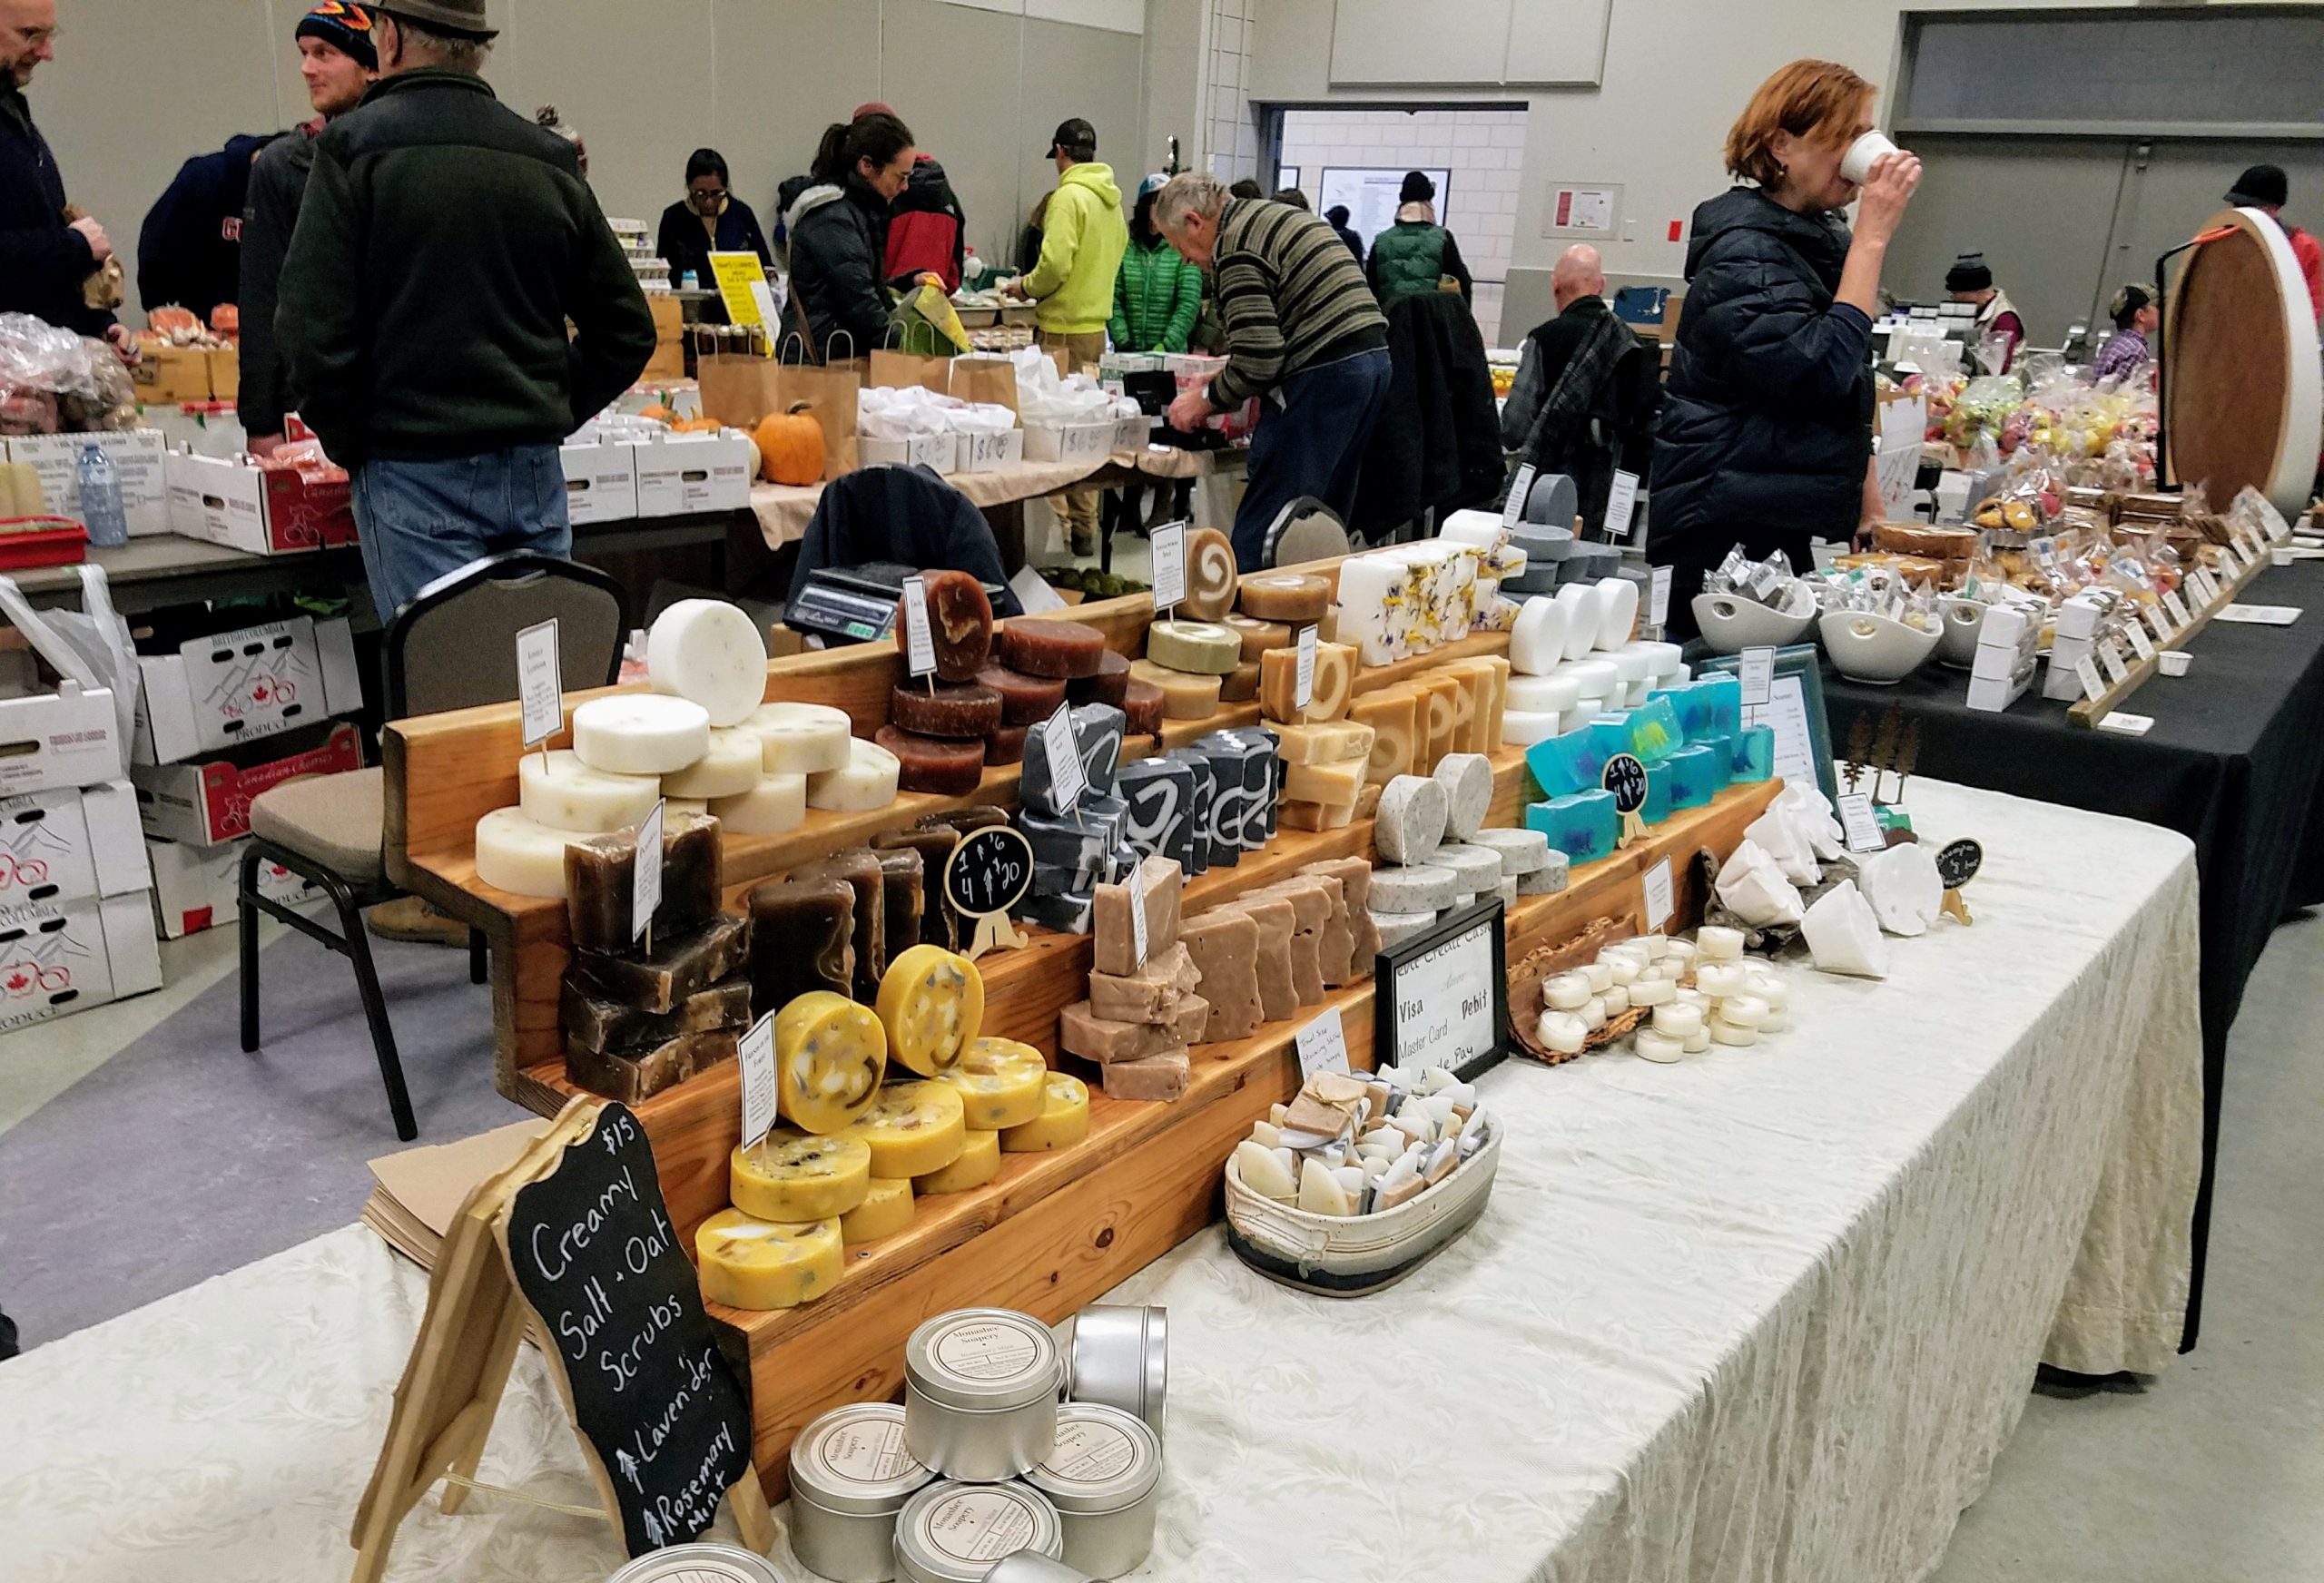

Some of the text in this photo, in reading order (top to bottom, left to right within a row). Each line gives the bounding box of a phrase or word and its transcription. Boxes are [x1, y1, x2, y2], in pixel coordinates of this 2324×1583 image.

[237, 767, 290, 789] Canadian
[1610, 764, 1619, 778] 1
[959, 850, 970, 873] 1
[962, 877, 973, 904] 4
[1399, 988, 1488, 1024] Visa Debit
[1398, 1018, 1448, 1061] Master Card
[1420, 1045, 1474, 1085] Ale Pay
[601, 1116, 635, 1155] $15
[532, 1165, 639, 1281] Creamy
[560, 1275, 614, 1360] Salt
[625, 1208, 670, 1274] Oat
[601, 1294, 682, 1392] Scrubs
[953, 1325, 1000, 1338] Monashee
[960, 1333, 1000, 1344] Soapery
[635, 1348, 713, 1463] Lavender
[829, 1431, 848, 1462] Monashee
[1054, 1423, 1082, 1440] nashee
[843, 1435, 862, 1460] Soapery
[656, 1421, 735, 1537] Rosemary
[686, 1470, 725, 1534] Mint
[933, 1499, 963, 1530] Monashee
[949, 1506, 975, 1531] Soapery
